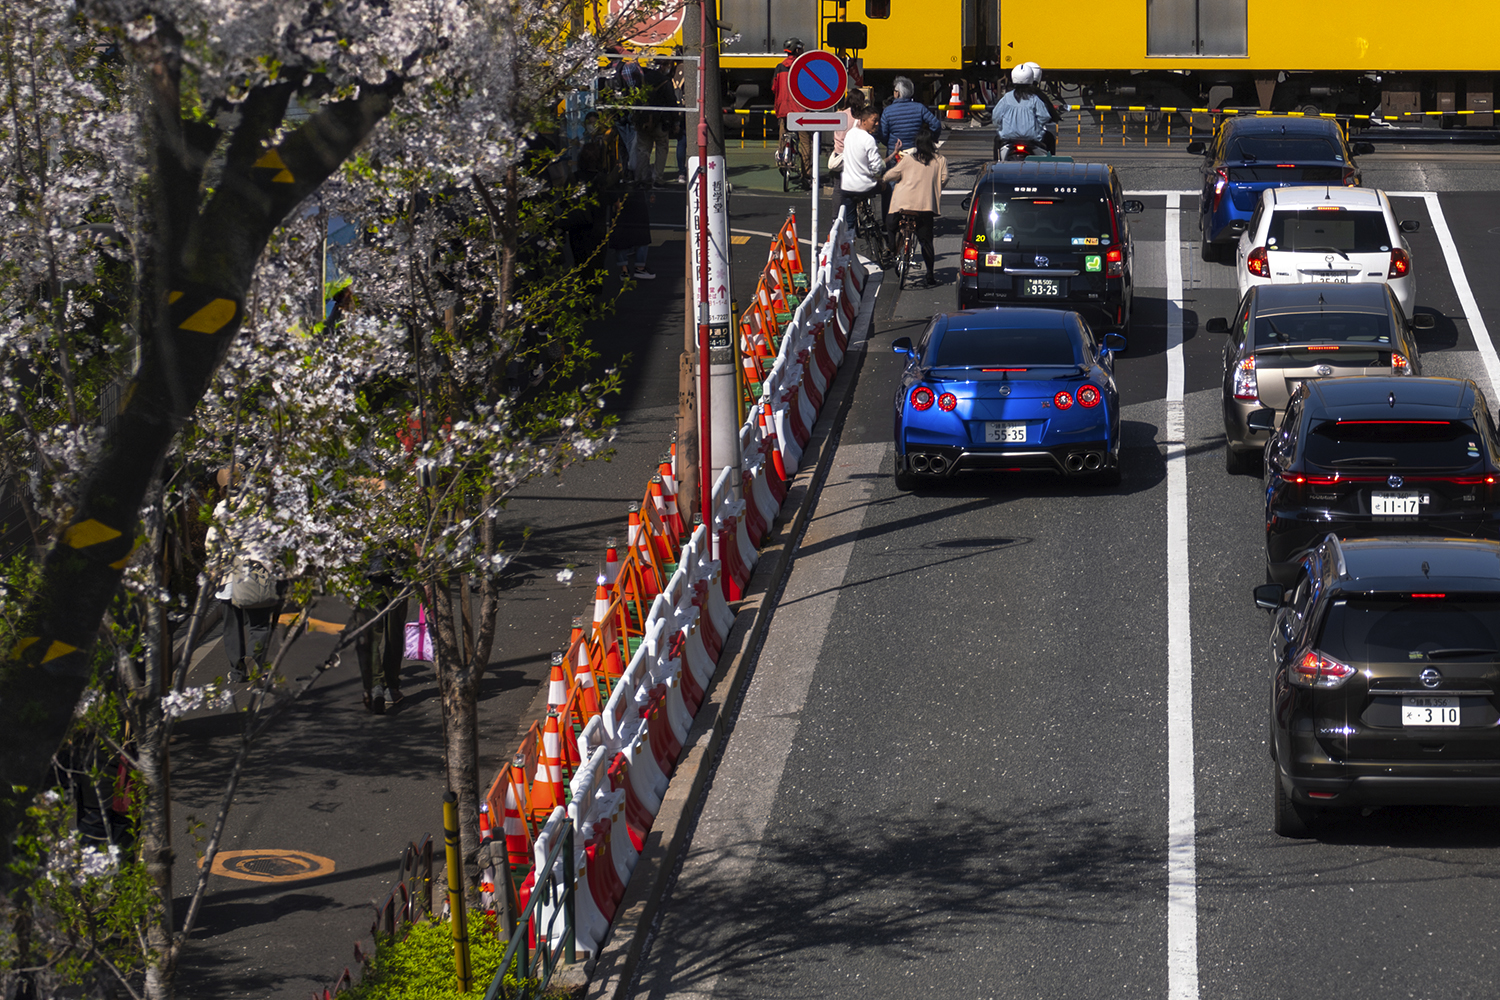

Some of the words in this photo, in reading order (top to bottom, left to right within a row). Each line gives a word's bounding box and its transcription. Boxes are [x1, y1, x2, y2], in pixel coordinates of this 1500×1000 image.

[712, 180, 723, 214] 哲学堂
[975, 234, 986, 242] 20
[1031, 285, 1058, 296] 93-25
[994, 429, 1025, 441] 55-35
[1384, 500, 1416, 513] 11-17
